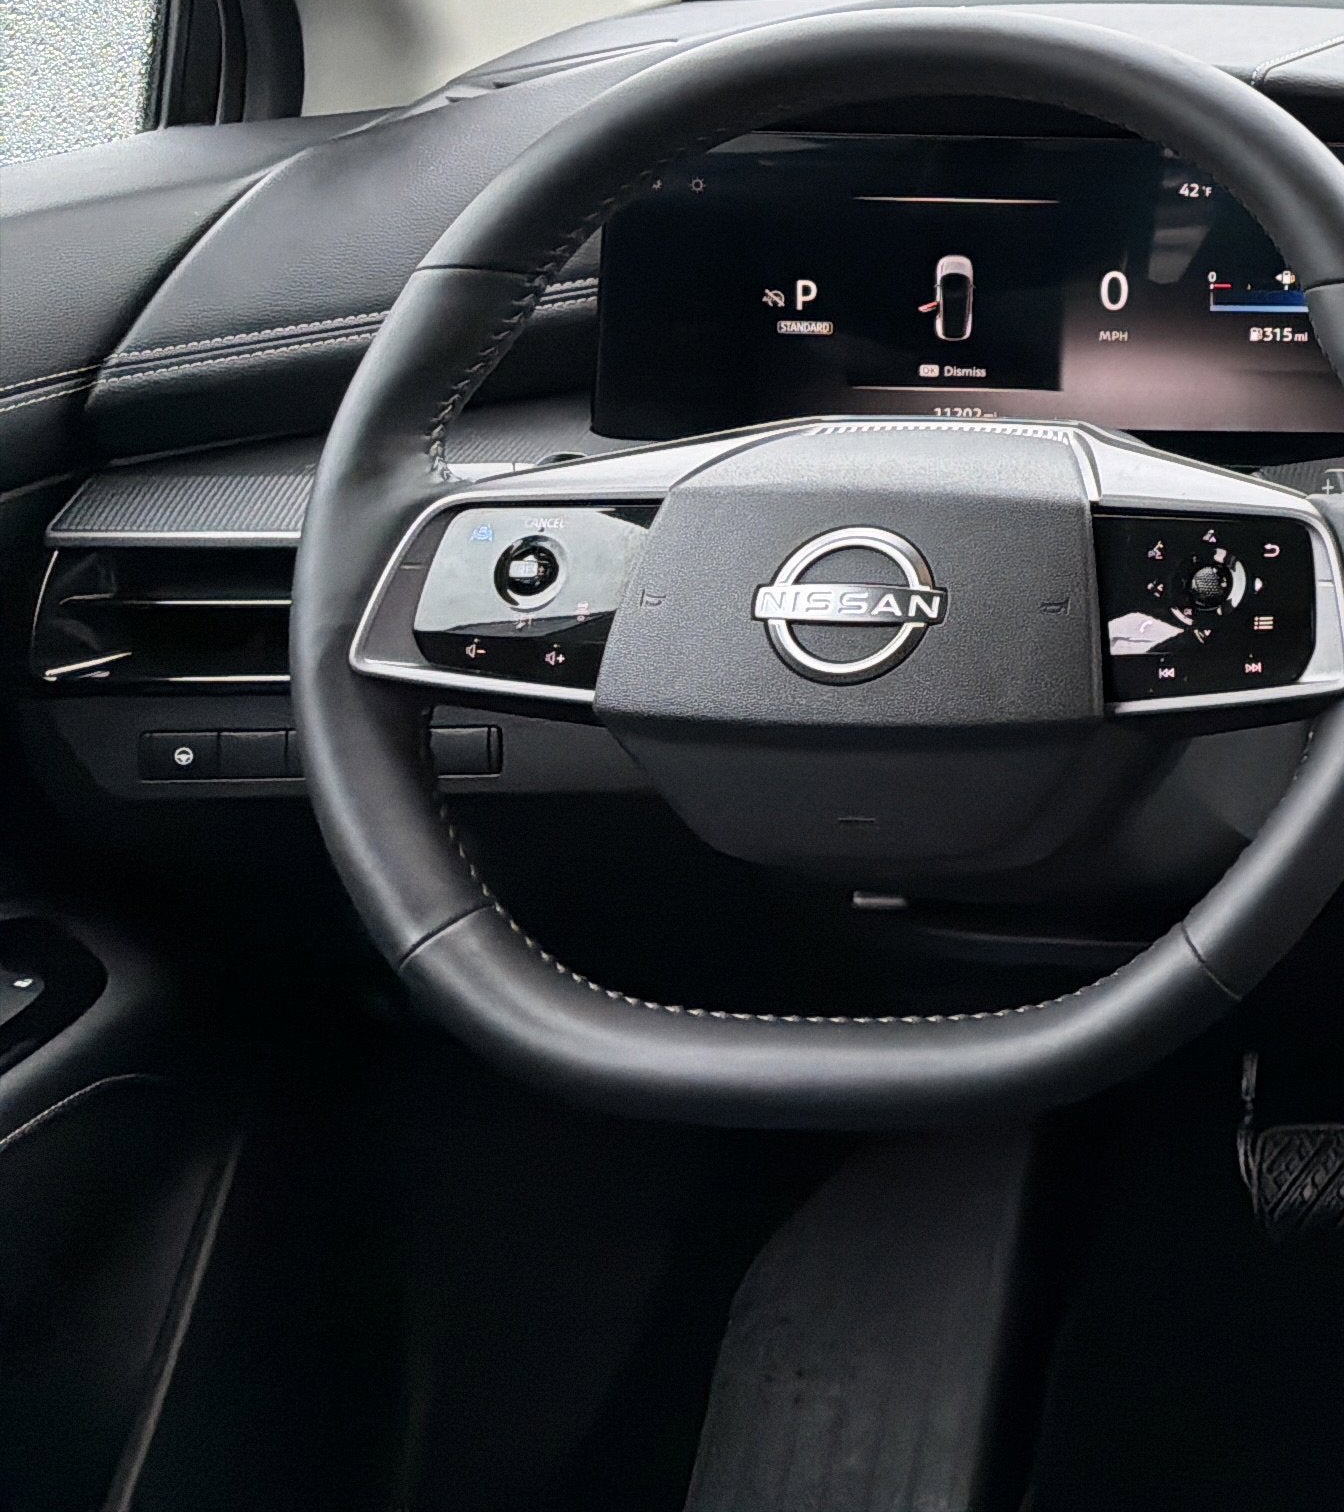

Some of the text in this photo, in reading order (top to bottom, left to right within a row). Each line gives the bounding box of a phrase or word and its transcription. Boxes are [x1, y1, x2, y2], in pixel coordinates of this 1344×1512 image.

[1178, 183, 1200, 198] 42
[796, 279, 818, 311] P
[1100, 270, 1129, 311] 0
[780, 322, 830, 333] STANDARD
[1262, 327, 1293, 342] 315
[1099, 331, 1128, 342] MPH
[943, 365, 987, 378] Dismiss
[759, 590, 941, 619] NISSAN
